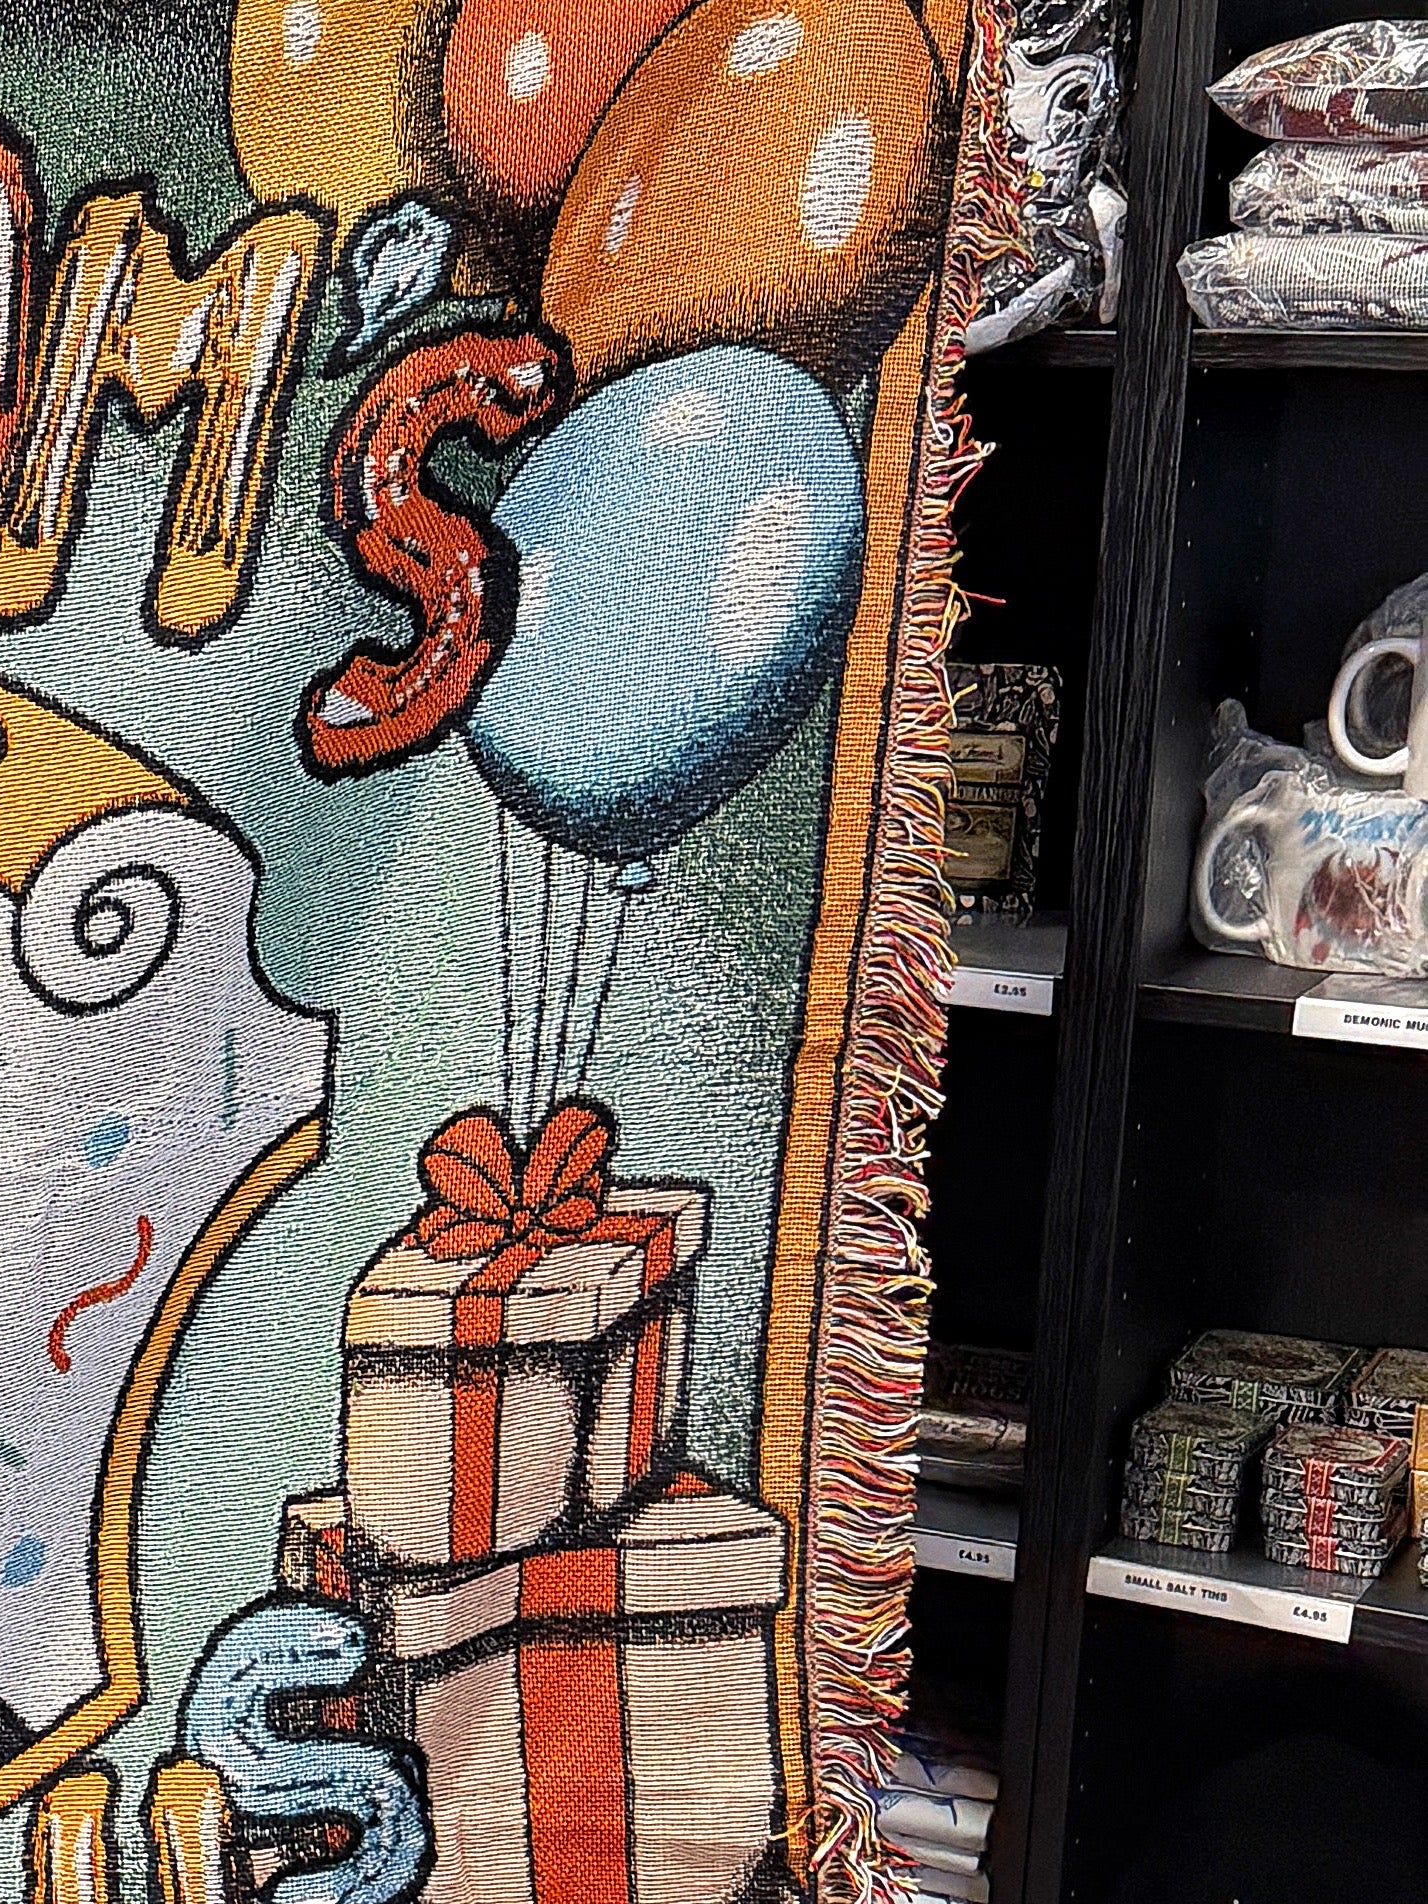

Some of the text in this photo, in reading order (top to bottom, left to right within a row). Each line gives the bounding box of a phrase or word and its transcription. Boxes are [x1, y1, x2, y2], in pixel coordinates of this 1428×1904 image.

[1344, 1014, 1401, 1029] DEMONIC
[1125, 1575, 1328, 1622] SMALL SALT TINS £4.95
